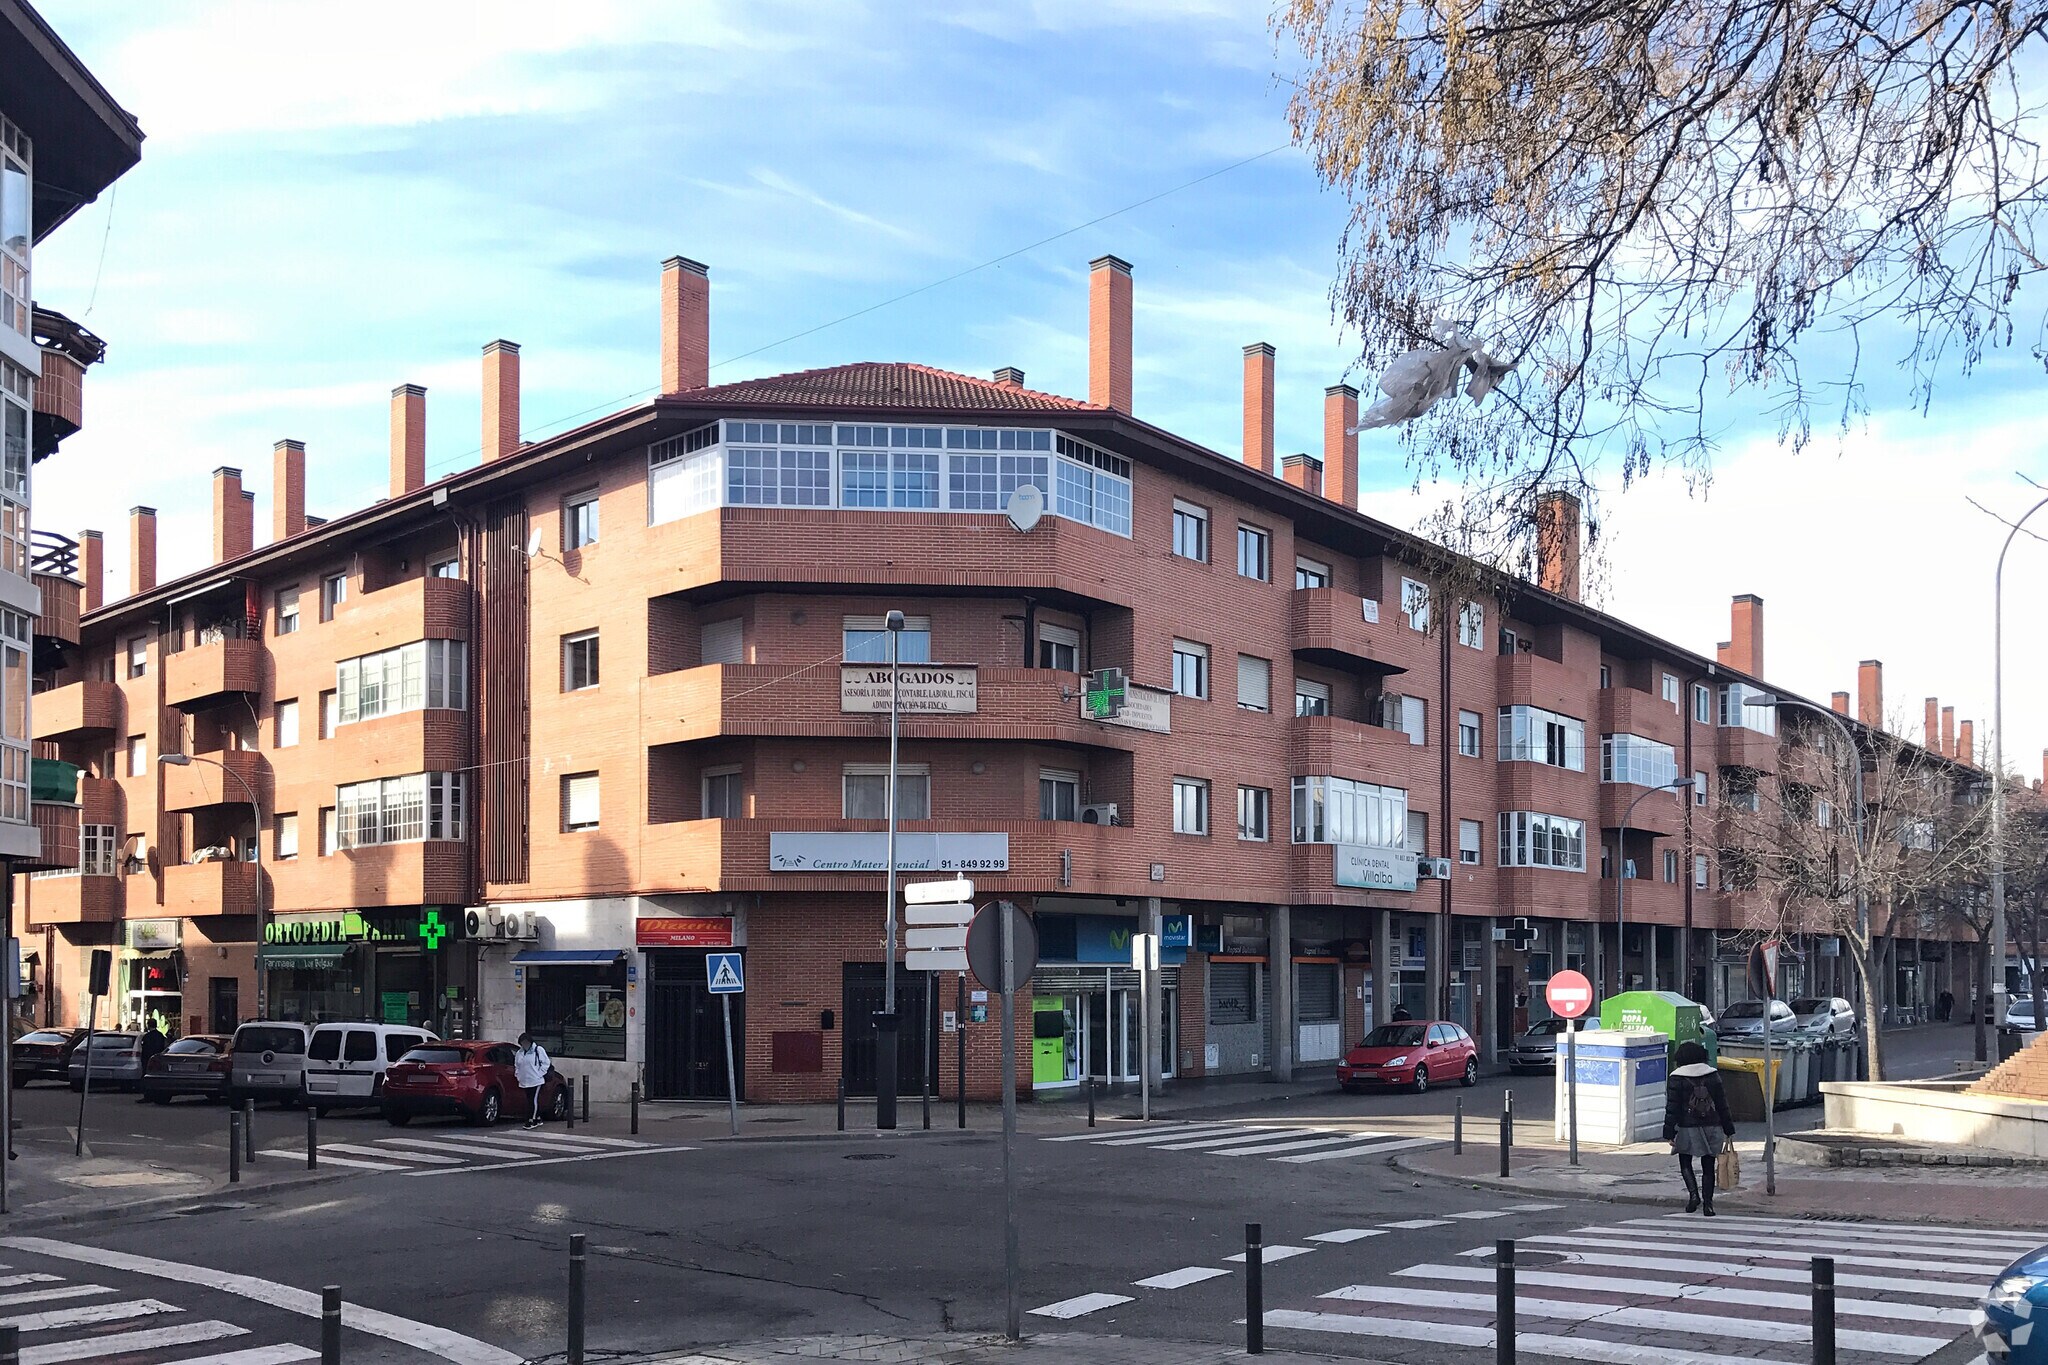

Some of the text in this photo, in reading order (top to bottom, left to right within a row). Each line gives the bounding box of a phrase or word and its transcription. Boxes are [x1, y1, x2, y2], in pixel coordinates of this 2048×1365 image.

[871, 687, 894, 698] JURÍDIC
[956, 690, 976, 699] FISCAL
[813, 859, 848, 869] Centro
[850, 859, 883, 869] Mater
[886, 859, 930, 869] encial
[941, 859, 952, 869] 91
[960, 859, 978, 869] 849
[980, 859, 991, 869] 92
[993, 859, 1005, 869] 99
[1372, 859, 1390, 869] DENTAL
[1362, 869, 1393, 884] Villalba
[265, 920, 346, 943] ORTOPEDIA
[640, 919, 724, 932] Pizzeria
[1621, 1014, 1647, 1025] ROPA y
